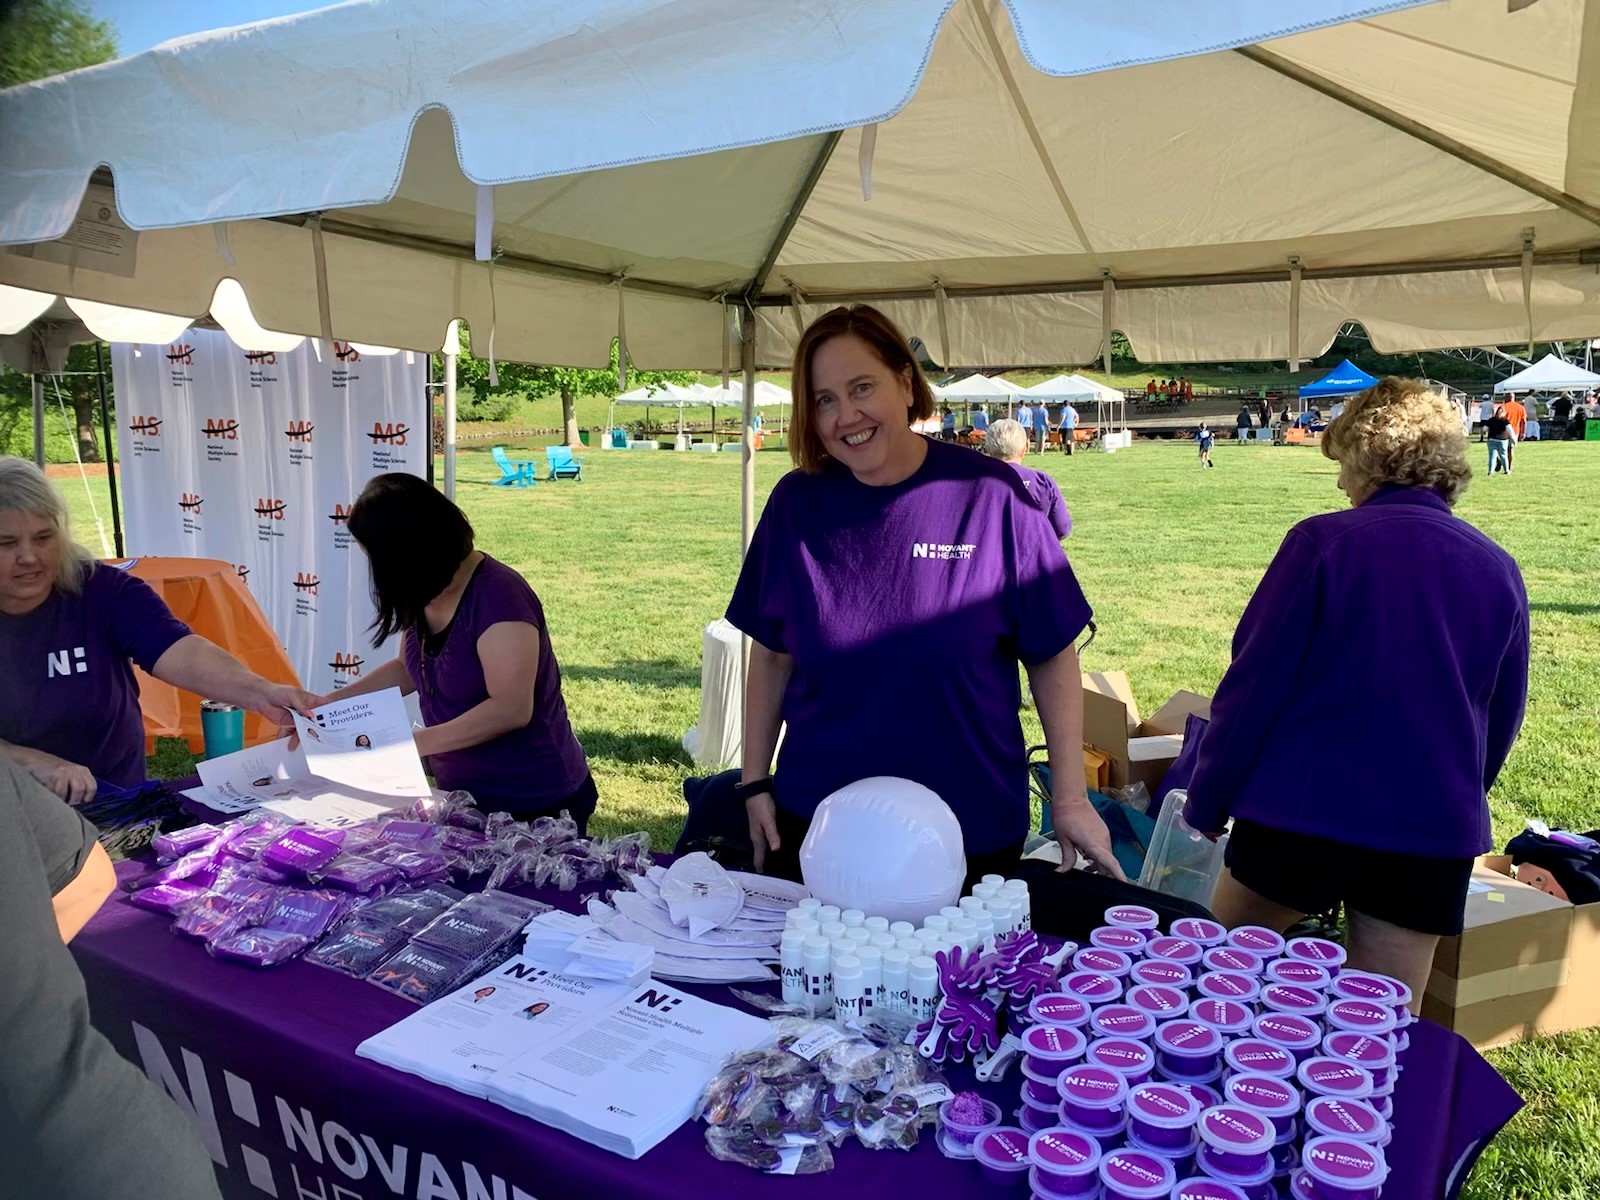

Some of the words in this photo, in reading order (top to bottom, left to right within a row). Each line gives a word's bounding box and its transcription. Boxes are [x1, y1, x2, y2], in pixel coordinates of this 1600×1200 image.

[170, 344, 191, 365] MS
[133, 416, 159, 436] MS
[207, 418, 237, 440] MS
[289, 421, 312, 442] MS
[373, 422, 406, 446] MS
[182, 493, 201, 515] MS
[258, 498, 284, 521] MS
[334, 504, 352, 526] M
[297, 572, 318, 596] MS
[334, 652, 360, 676] MS
[329, 708, 351, 719] Meet
[352, 703, 369, 712] Our
[296, 844, 321, 855] NOVANT
[293, 908, 318, 918] NOVANT
[421, 959, 446, 971] NOVANT
[549, 974, 574, 984] Meet
[574, 981, 594, 990] Our
[624, 1005, 648, 1016] Novant
[648, 1013, 672, 1024] Health
[672, 1021, 704, 1035] Multiple
[648, 1020, 665, 1028] Care
[1087, 1079, 1118, 1087] NOVANT
[1256, 1087, 1289, 1098] NOVANT
[1157, 1097, 1188, 1114] NOVANT
[1230, 1120, 1262, 1138] NOVANT
[1060, 1143, 1088, 1161] NOVANT
[1337, 1155, 1374, 1166] NOVANT
[1131, 1165, 1164, 1182] NOVANT
